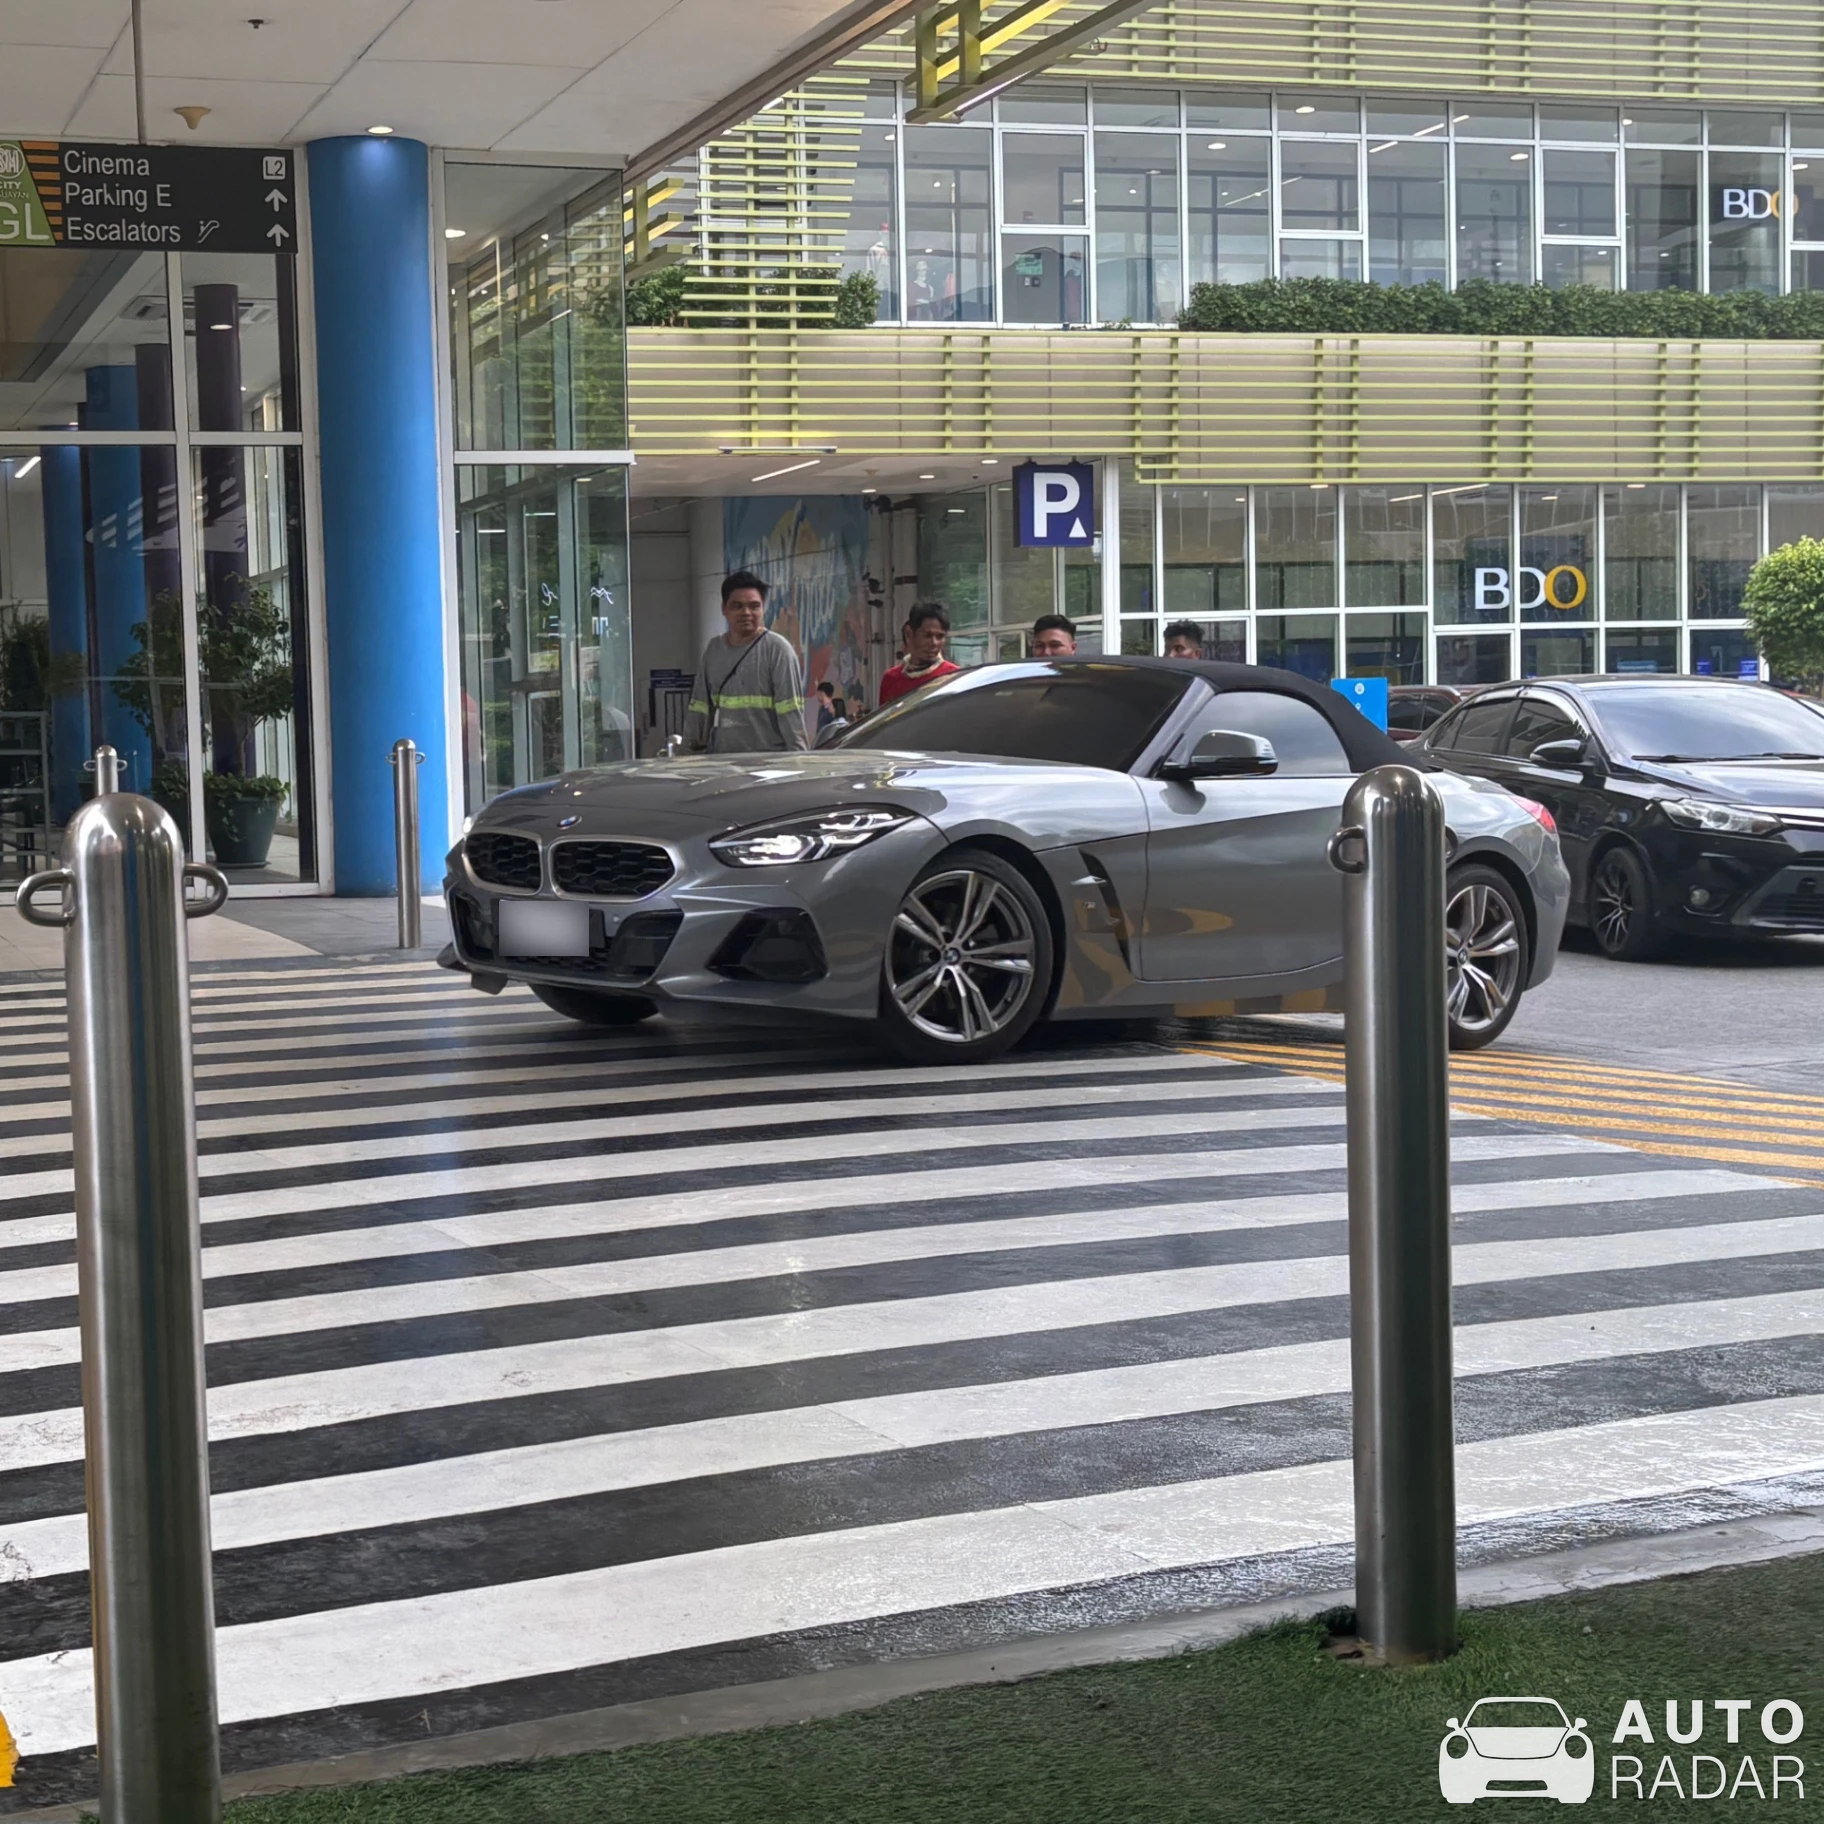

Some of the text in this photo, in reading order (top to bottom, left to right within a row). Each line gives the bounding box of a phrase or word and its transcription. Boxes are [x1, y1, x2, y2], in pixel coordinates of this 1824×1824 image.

[64, 150, 150, 176] Cinema
[265, 159, 284, 177] L2
[65, 182, 172, 213] Parking E
[67, 217, 181, 243] Escalators
[1033, 472, 1080, 538] P
[1475, 565, 1587, 610] BDO
